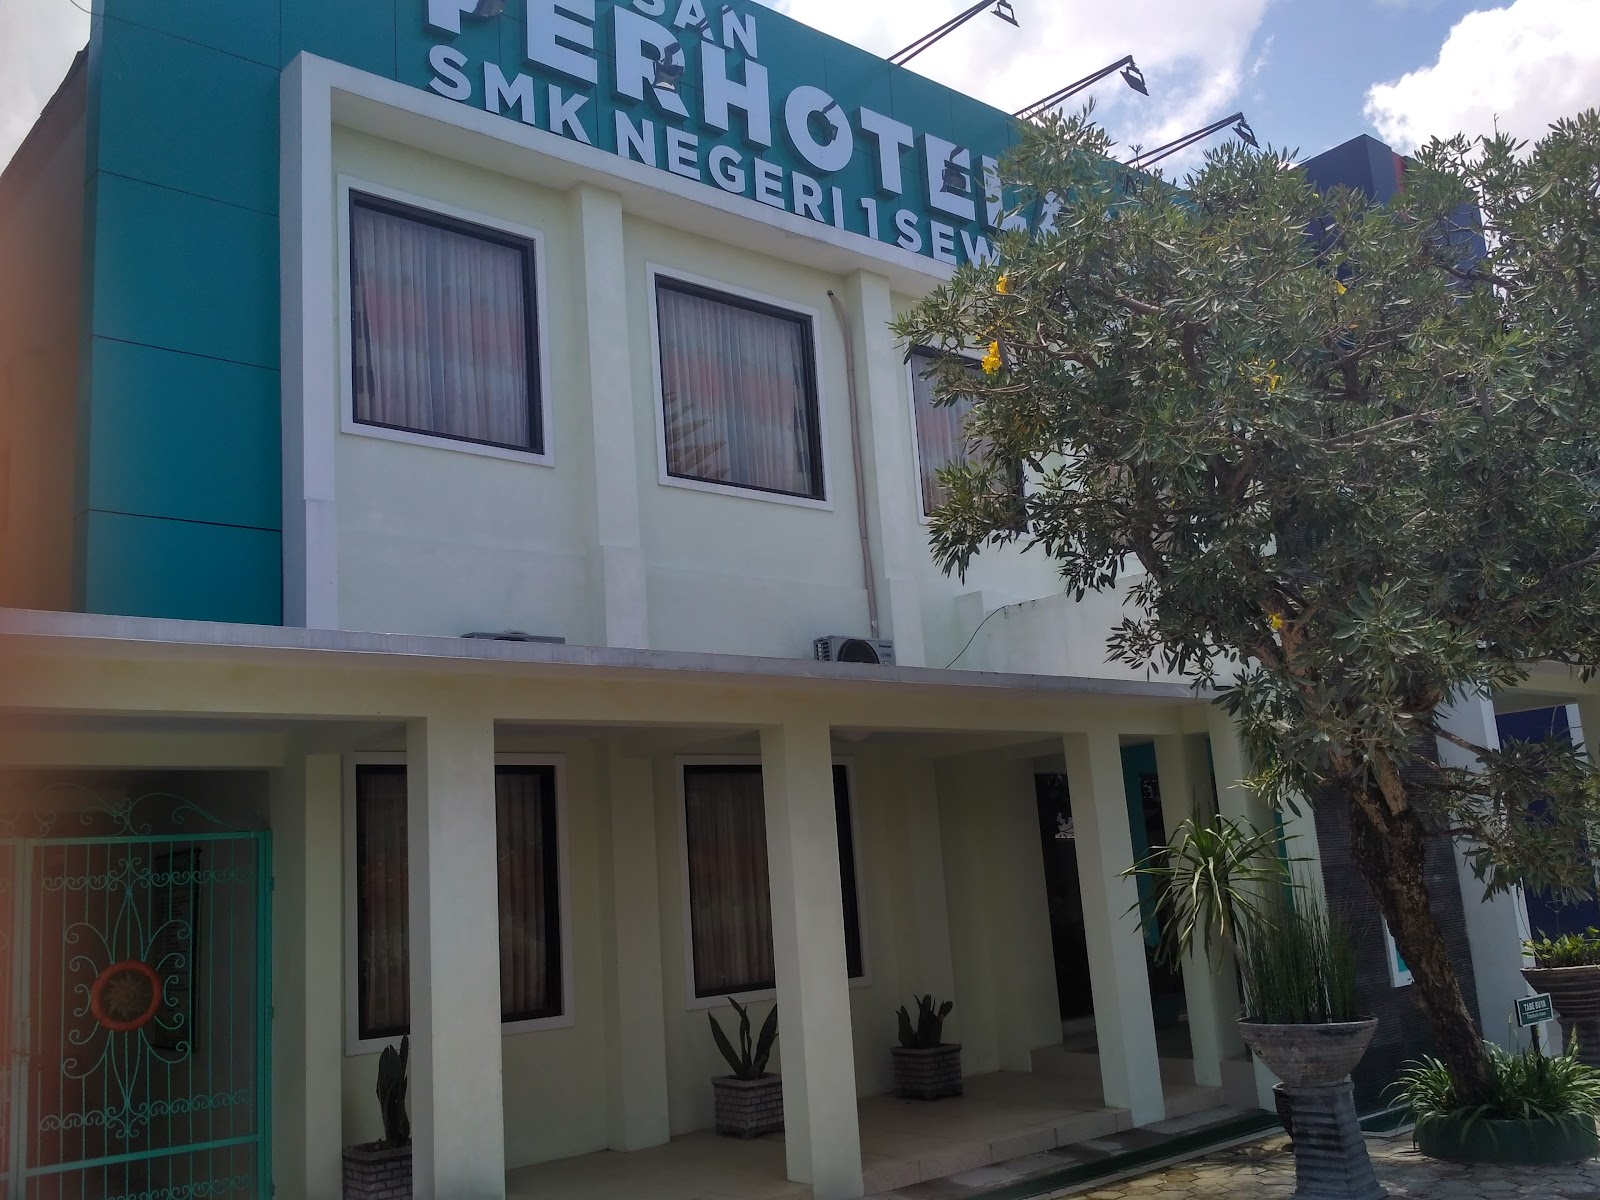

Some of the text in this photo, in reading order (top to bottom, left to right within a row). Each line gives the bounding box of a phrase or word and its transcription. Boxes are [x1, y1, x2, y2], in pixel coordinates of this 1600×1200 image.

[429, 45, 592, 144] SMK
[614, 109, 844, 230] NEGERI
[860, 197, 879, 240] 1
